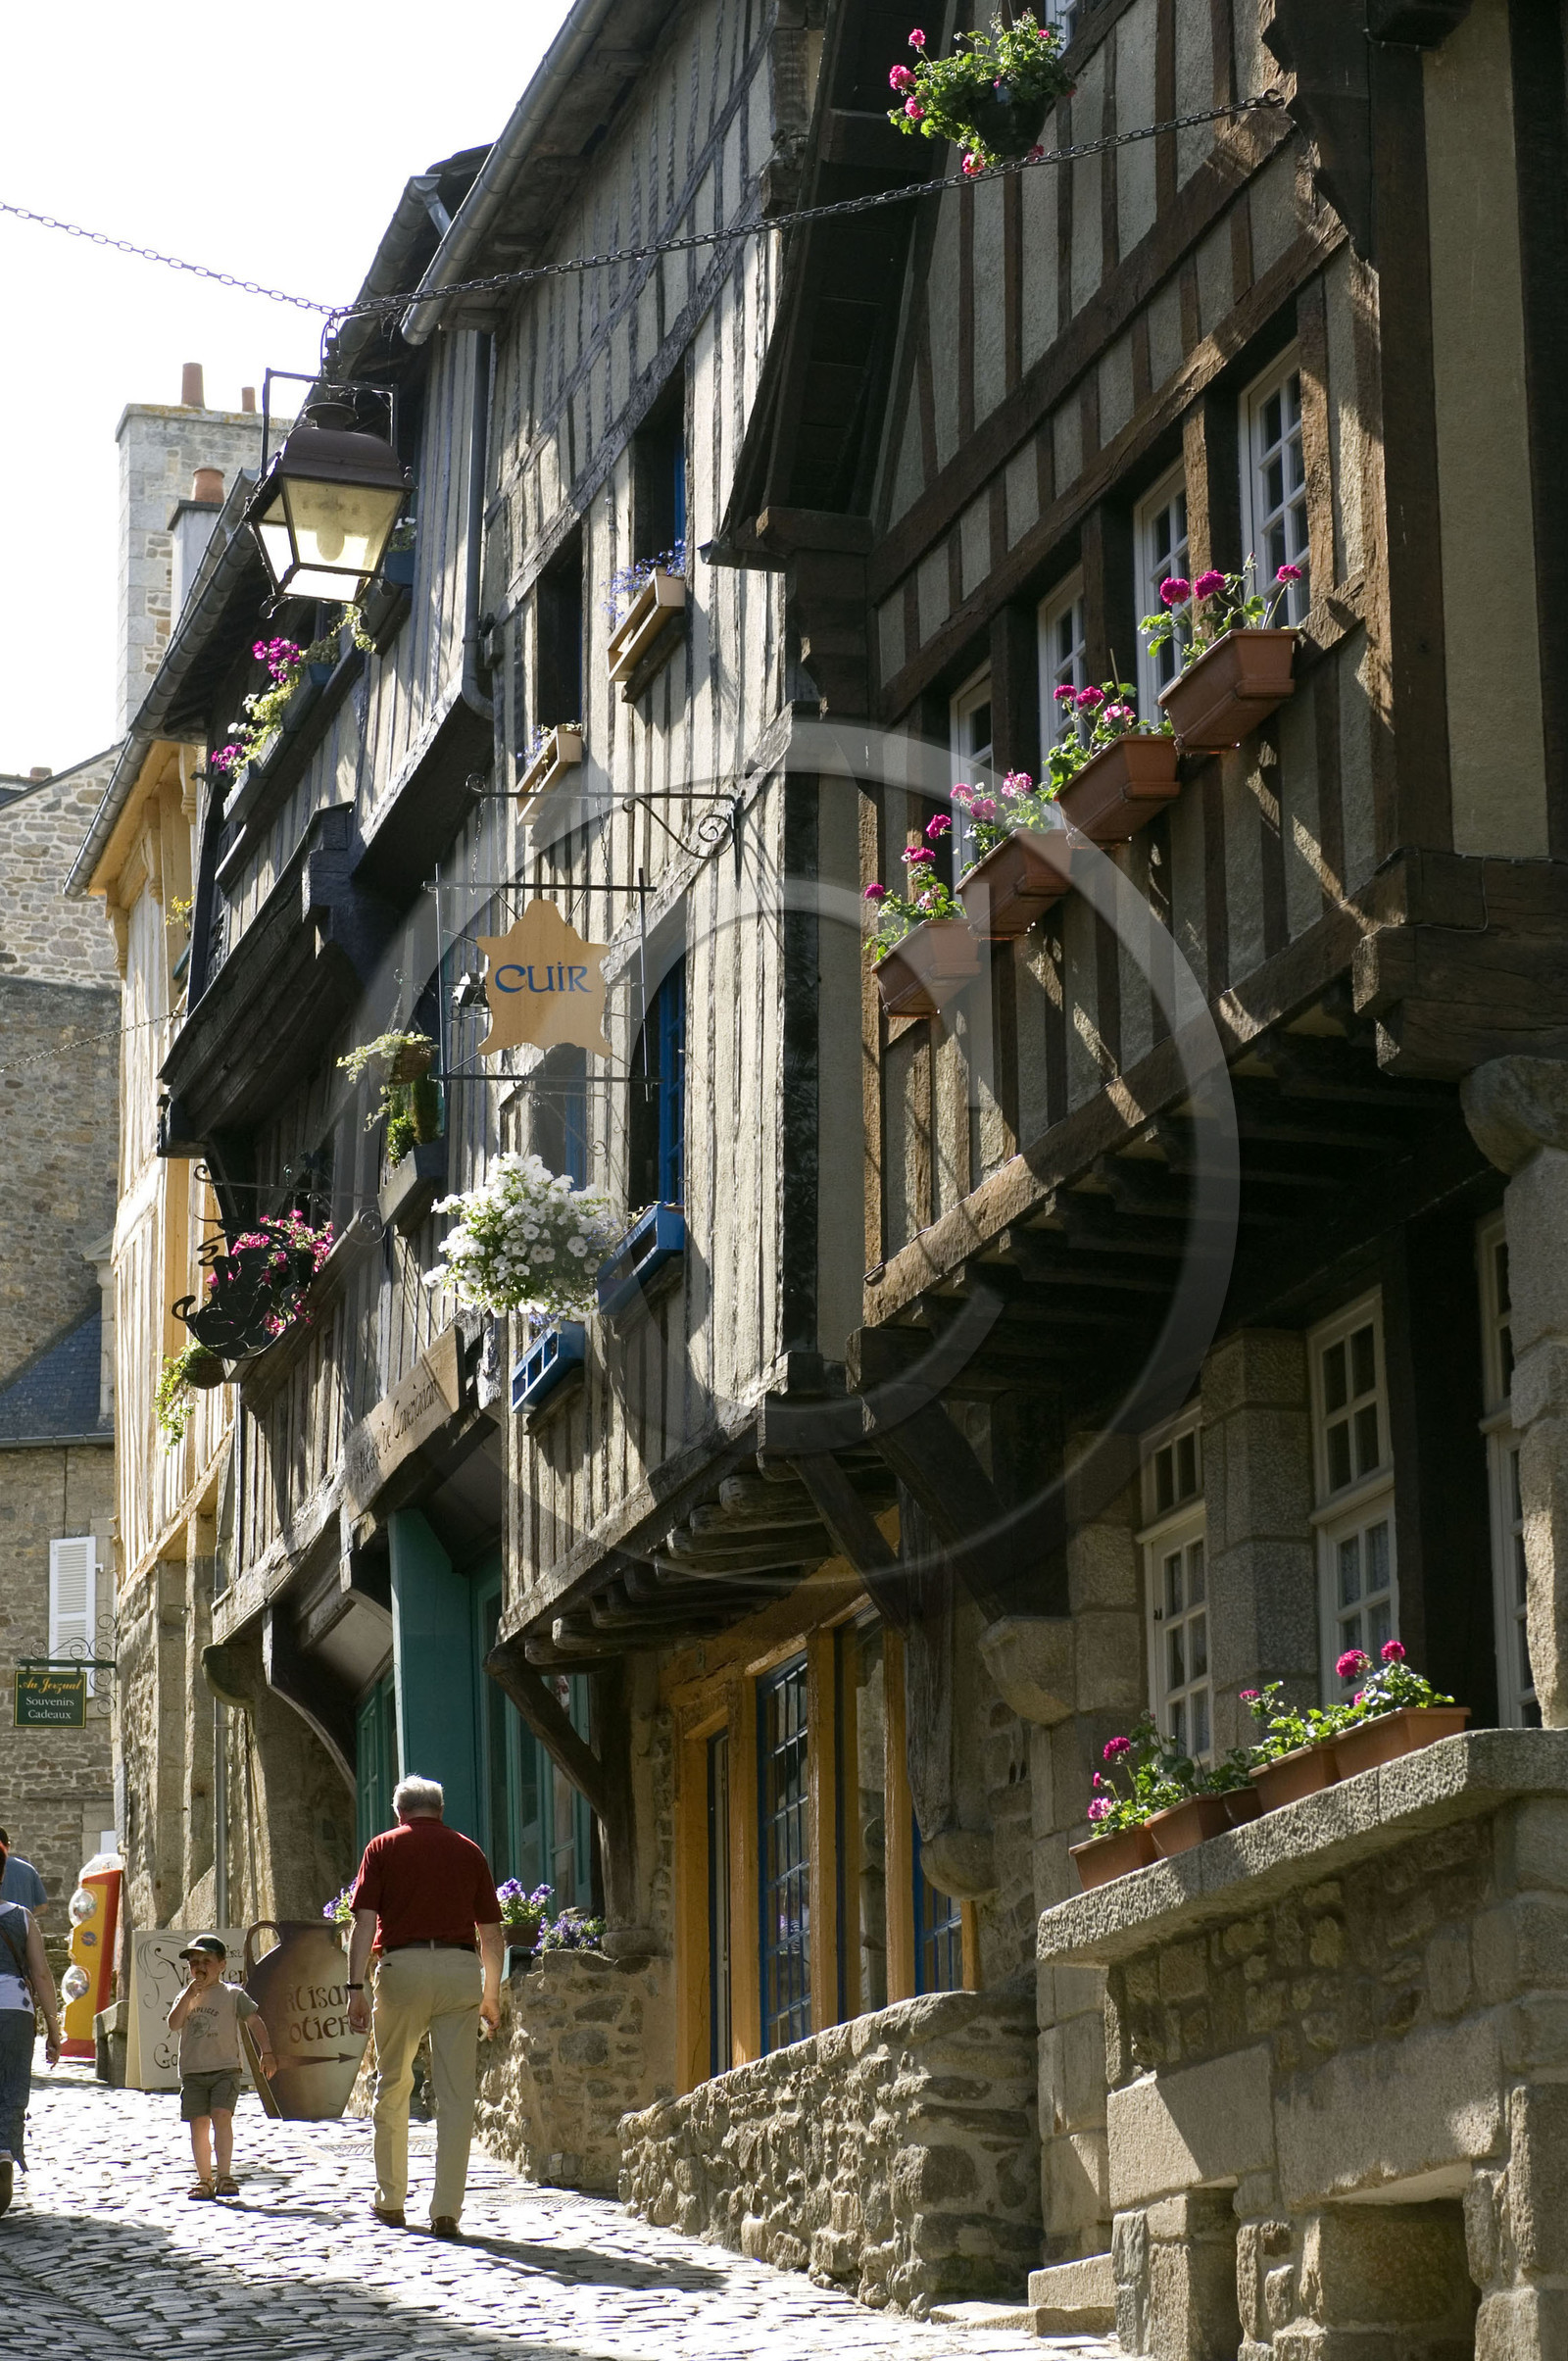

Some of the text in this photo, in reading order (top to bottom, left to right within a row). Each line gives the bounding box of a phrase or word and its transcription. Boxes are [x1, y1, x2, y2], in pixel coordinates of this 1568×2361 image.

[19, 1676, 38, 1690] Au
[25, 1696, 74, 1706] Souvenirs
[27, 1708, 72, 1719] Cadeaux
